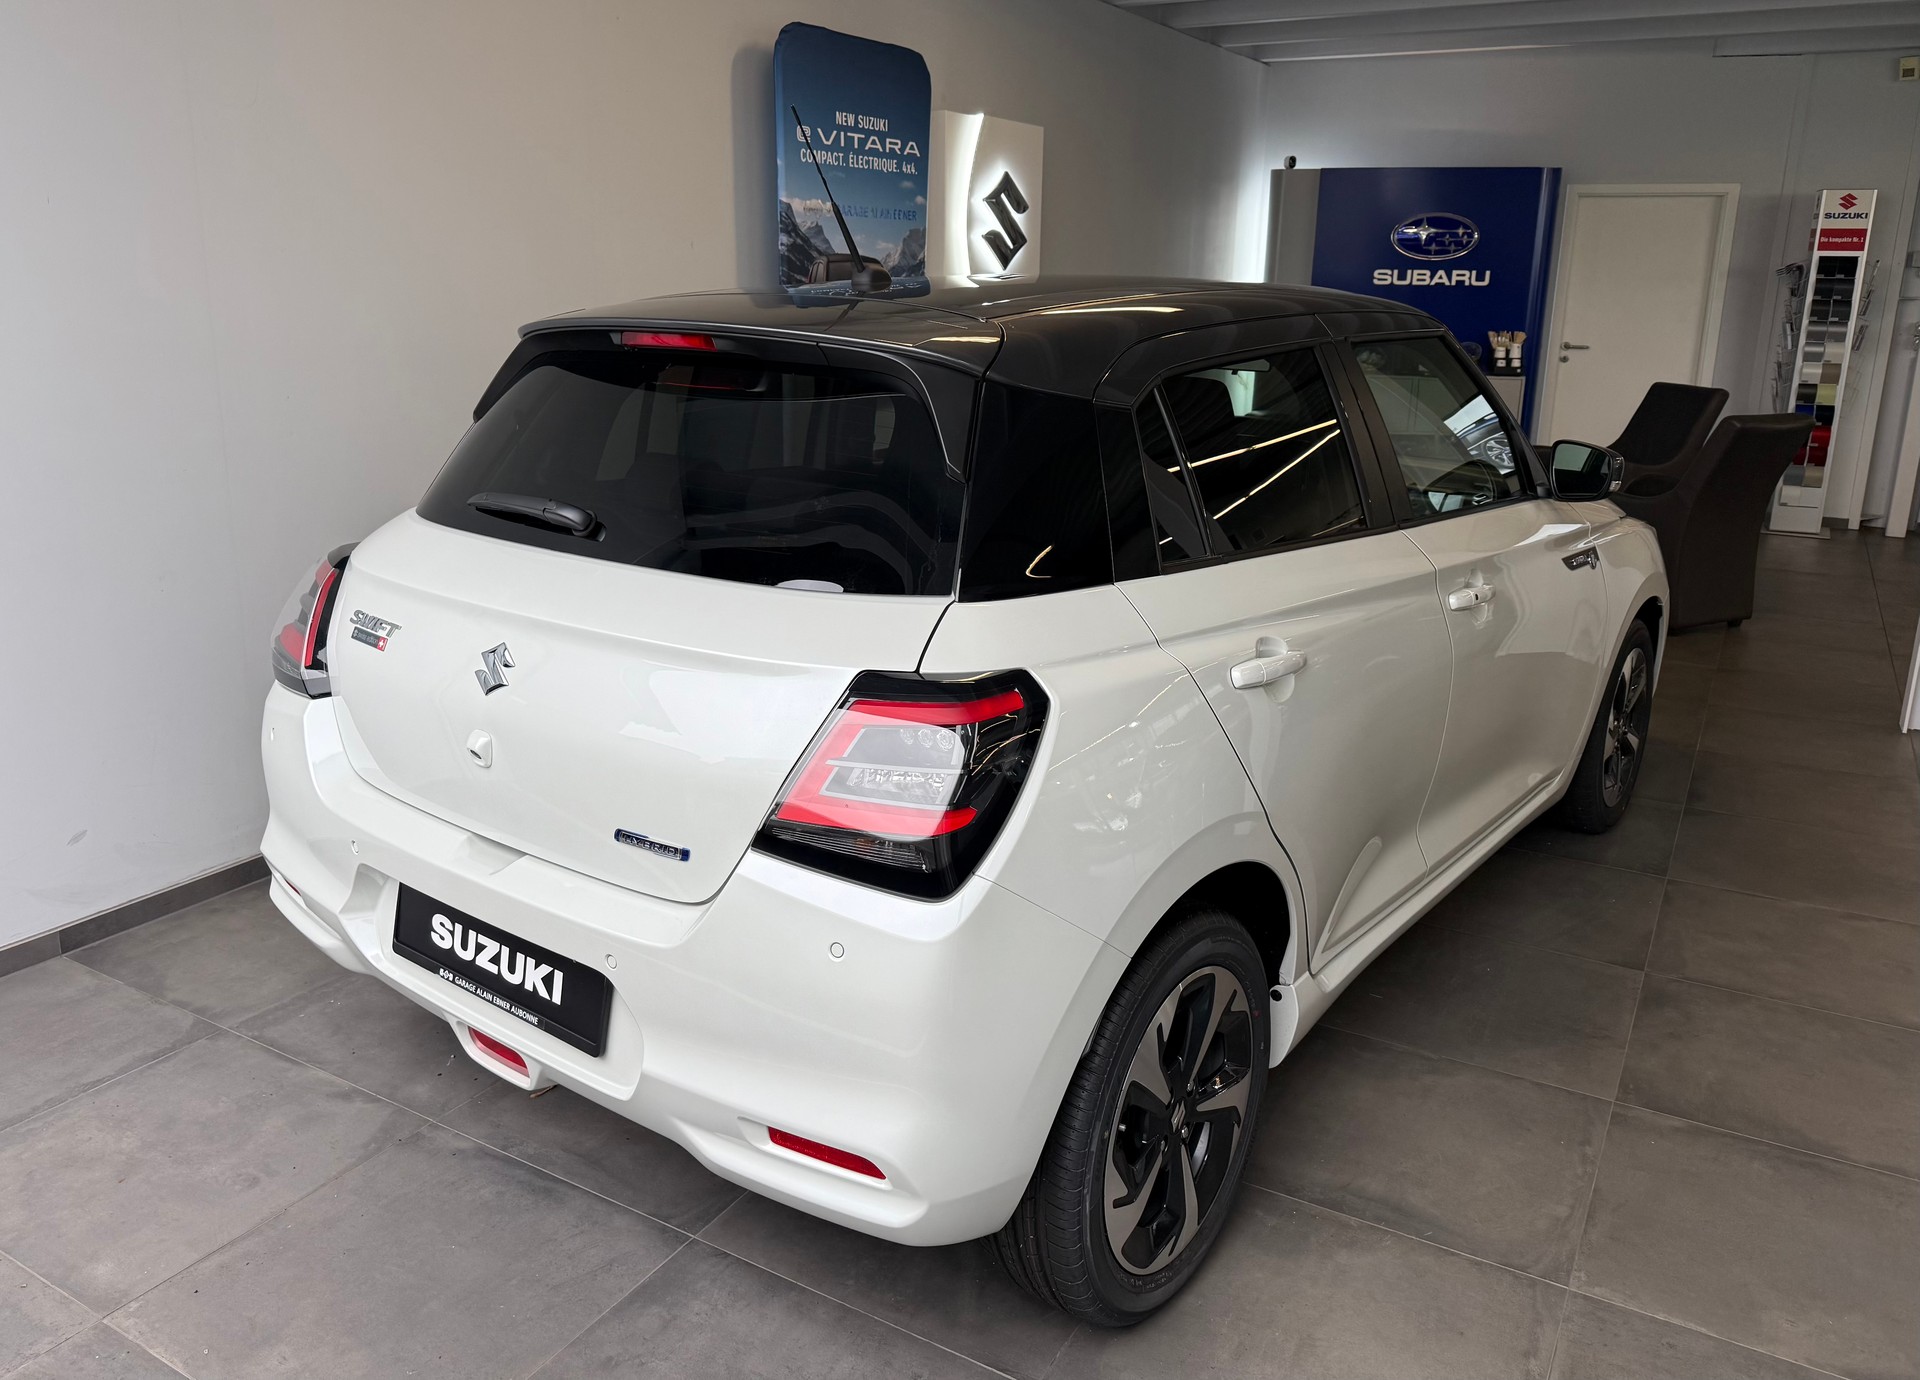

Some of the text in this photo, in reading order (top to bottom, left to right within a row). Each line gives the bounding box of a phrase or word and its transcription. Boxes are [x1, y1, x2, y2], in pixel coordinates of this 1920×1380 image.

[835, 111, 888, 132] NEW SUZUKI
[817, 128, 921, 157] VITARA
[800, 148, 918, 175] COMPACT. ÉLECTRIQUE. 4x4.
[1824, 212, 1869, 220] SUZUKI
[1373, 269, 1491, 286] SUBARU
[430, 913, 564, 1006] SUZUKI
[454, 976, 539, 1026] GARAGE ALAIN EBNER AUBONNE
